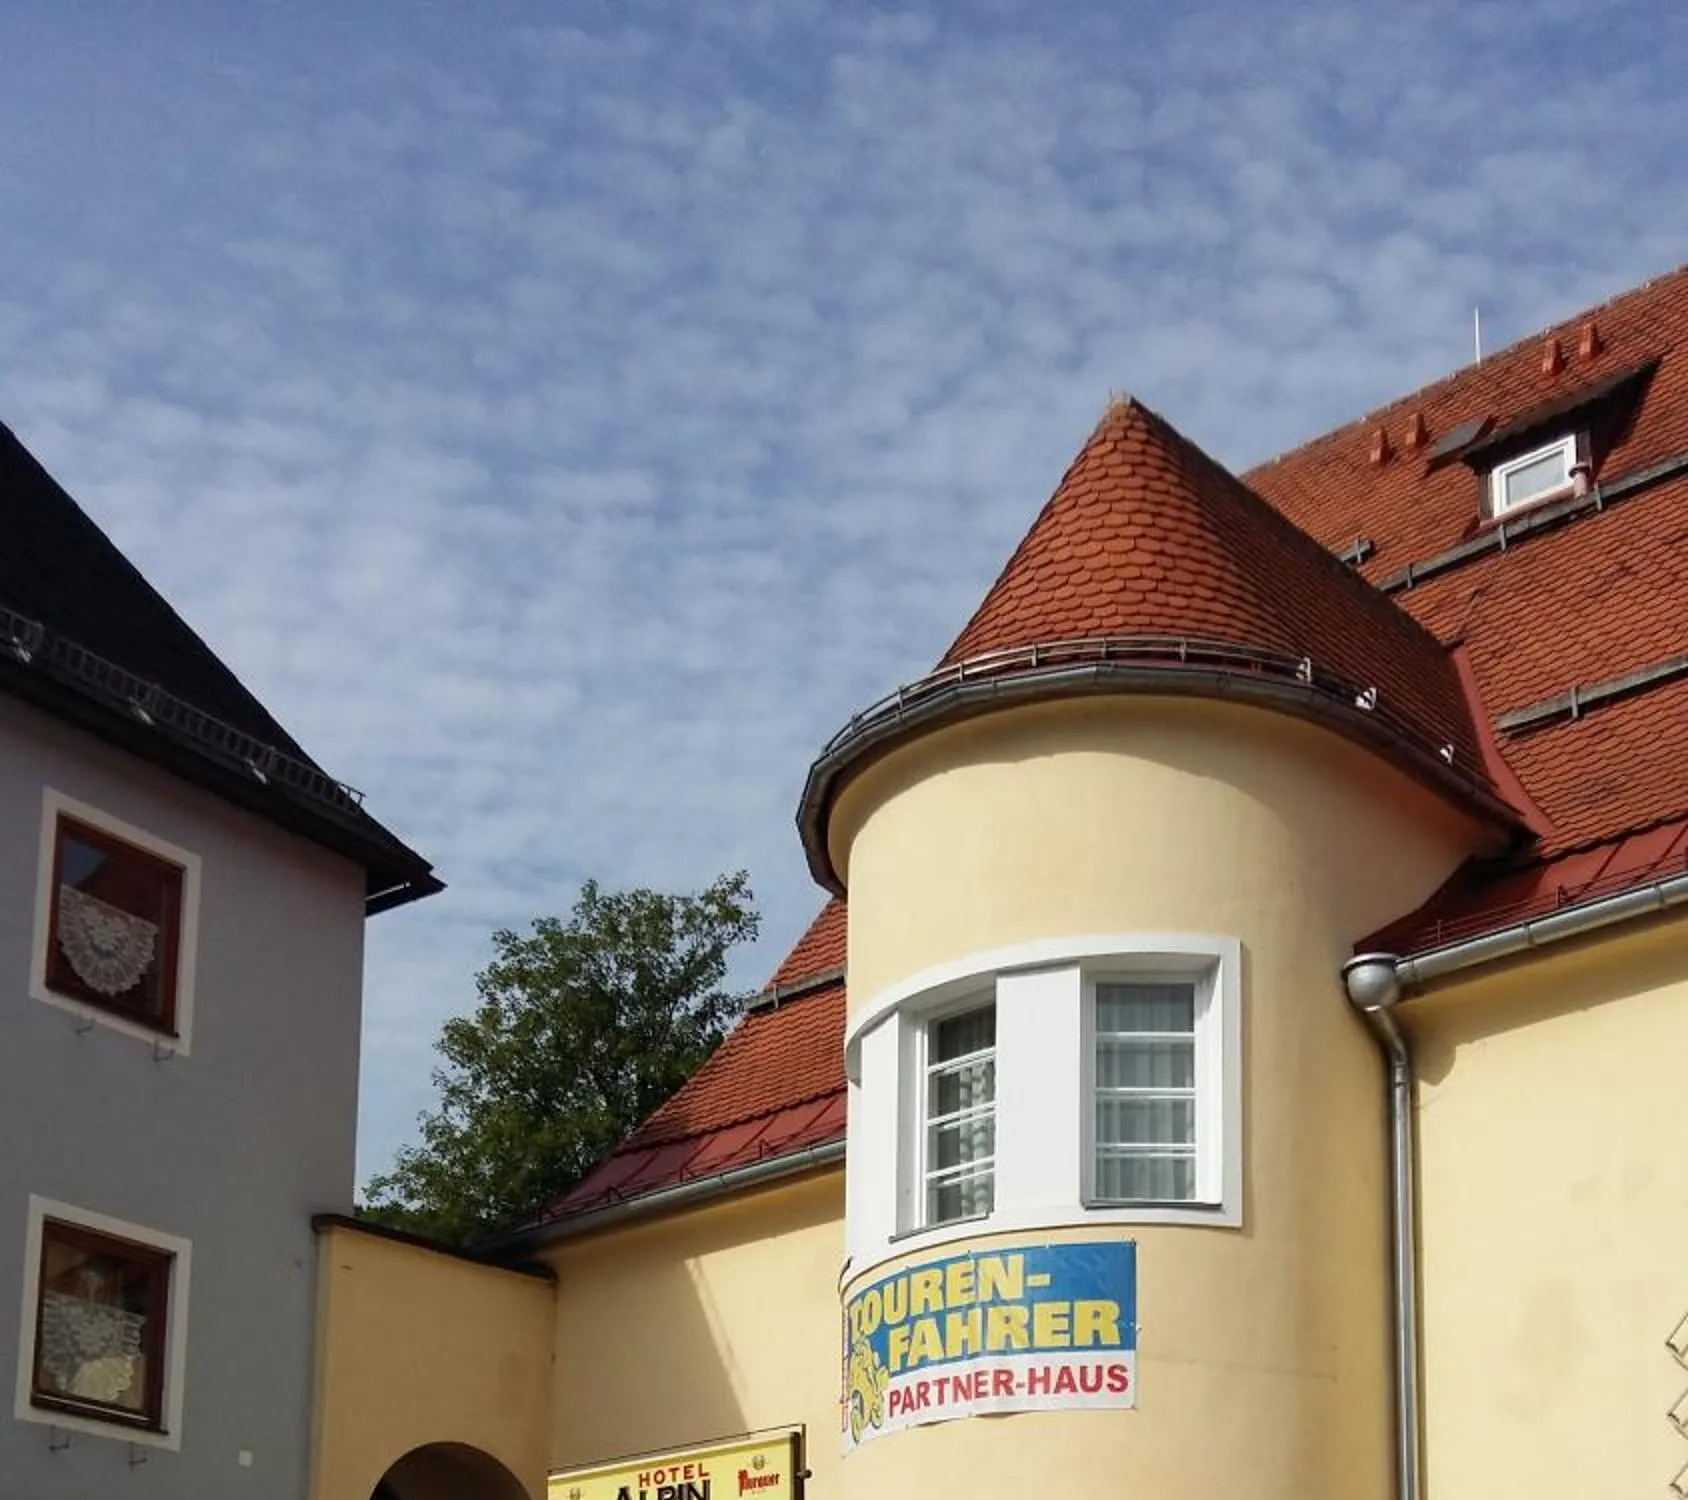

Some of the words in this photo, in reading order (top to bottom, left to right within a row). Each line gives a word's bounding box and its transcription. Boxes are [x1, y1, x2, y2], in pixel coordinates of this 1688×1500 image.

[850, 1254, 1051, 1341] TOUREN-
[888, 1300, 1121, 1373] FAHRER
[889, 1364, 1129, 1418] PARTNER-HAUS
[639, 1463, 710, 1488] HOTEL
